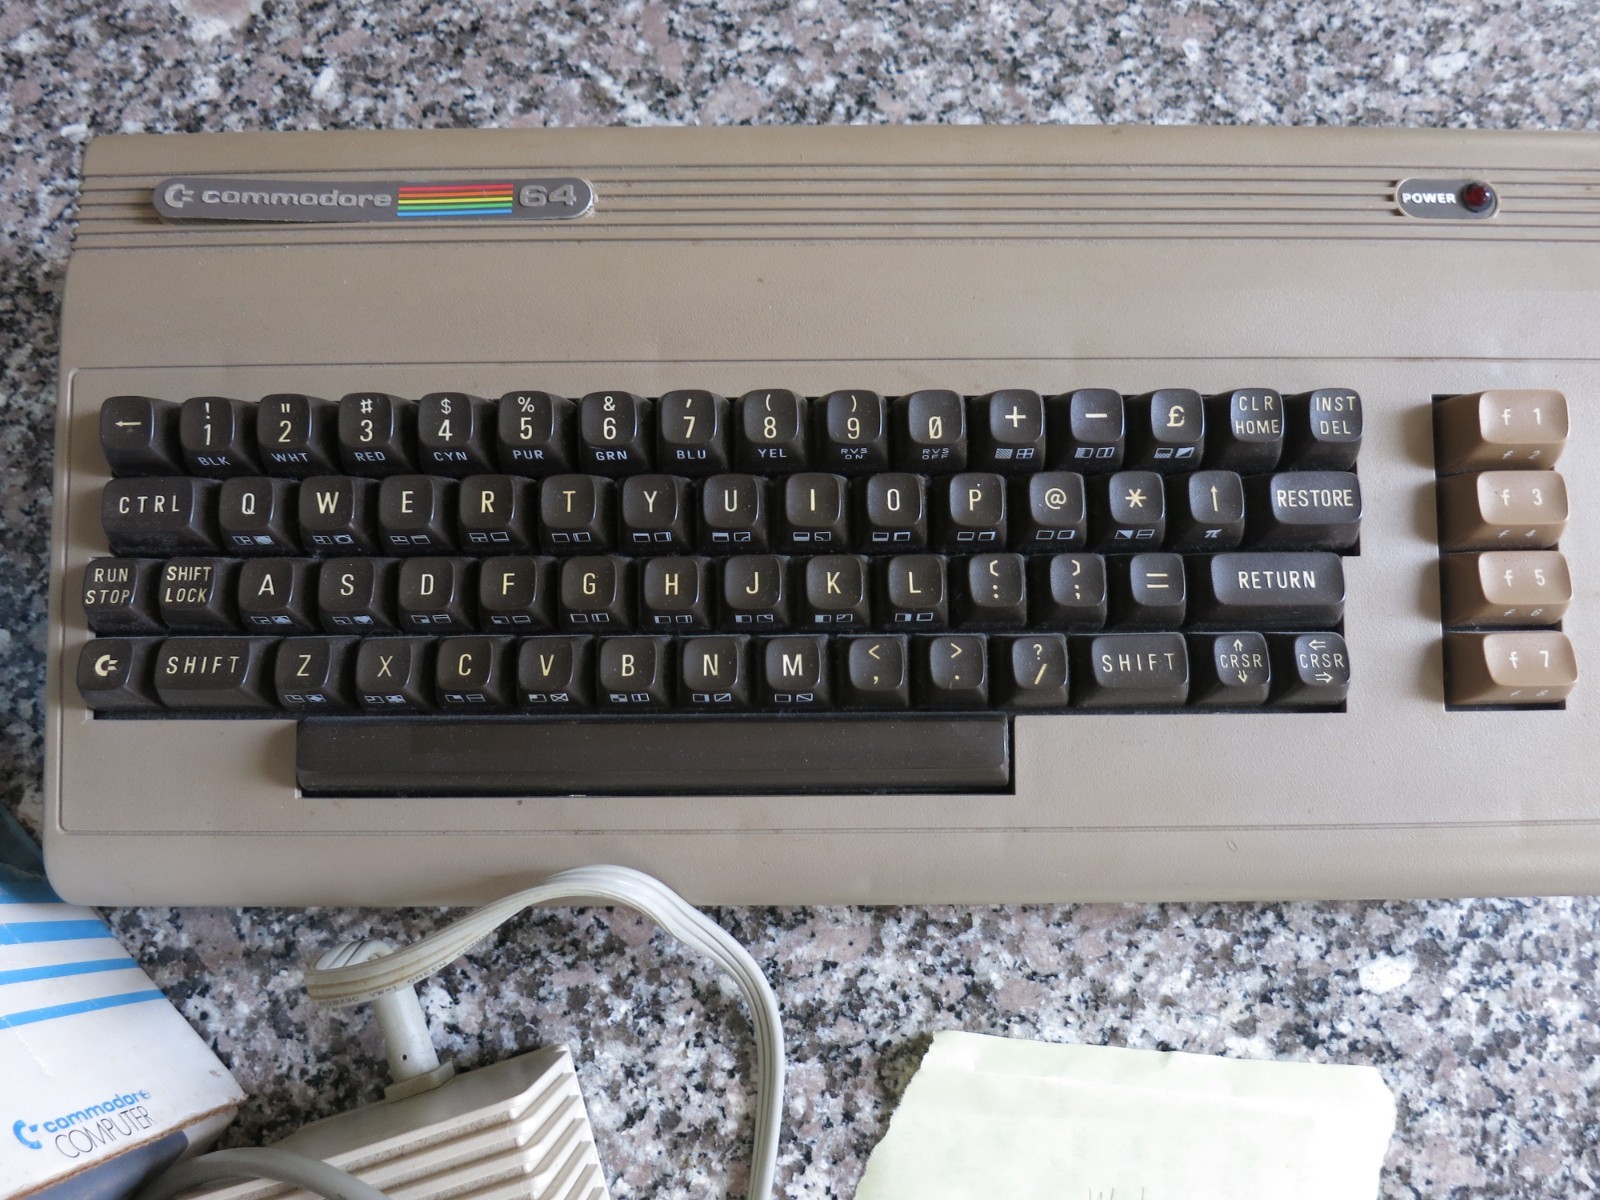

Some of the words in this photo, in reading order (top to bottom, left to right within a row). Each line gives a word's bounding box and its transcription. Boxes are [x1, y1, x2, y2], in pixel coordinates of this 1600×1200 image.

[201, 188, 392, 208] commodore
[519, 184, 577, 207] 64
[1402, 192, 1457, 204] POWER
[361, 399, 372, 413] #
[441, 398, 451, 414] $
[518, 397, 534, 412] %
[604, 396, 615, 411] &
[1239, 396, 1273, 411] CLR
[1316, 397, 1355, 411] INST
[1167, 406, 1184, 426] £
[1236, 419, 1279, 434] HOME
[204, 424, 211, 445] 1
[279, 421, 291, 442] 2
[360, 420, 372, 441] 3
[439, 420, 452, 441] 4
[520, 418, 532, 439] 5
[604, 418, 616, 439] 6
[684, 416, 695, 438] 7
[764, 417, 776, 438] 8
[848, 418, 859, 439] 9
[1320, 421, 1350, 434] DEL
[198, 457, 230, 465] BLK
[271, 453, 307, 462] WHT
[355, 452, 385, 461] RED
[434, 452, 467, 461] CYN
[513, 450, 543, 459] PUR
[596, 451, 627, 460] GRN
[677, 450, 705, 459] BLU
[758, 449, 786, 457] YEL
[120, 496, 179, 513] CTRL
[242, 493, 255, 514] Q
[317, 492, 338, 513] W
[402, 491, 413, 513] E
[482, 491, 494, 512] R
[563, 491, 575, 512] T
[644, 491, 657, 512] Y
[725, 490, 737, 511] U
[888, 489, 900, 510] O
[969, 490, 981, 510] P
[1045, 488, 1066, 509] @
[1277, 489, 1353, 508] RESTORE
[95, 568, 128, 582] RUN
[167, 566, 211, 580] SHIFT
[503, 573, 514, 594] F
[584, 573, 595, 594] G
[746, 572, 758, 594] J
[827, 572, 841, 593] K
[909, 572, 921, 593] L
[1239, 571, 1315, 588] RETURN
[165, 588, 206, 602] LOCK
[258, 574, 274, 595] A
[341, 574, 354, 595] S
[421, 574, 433, 595] D
[666, 574, 678, 595] H
[85, 590, 129, 604] STOP
[1034, 644, 1042, 660] ?
[1220, 654, 1261, 669] CRSR
[1300, 654, 1344, 668] CRSR
[167, 656, 239, 674] SHIFT
[297, 655, 311, 676] Z
[378, 656, 392, 677] X
[459, 654, 471, 675] C
[540, 655, 554, 676] V
[622, 655, 634, 676] B
[704, 654, 717, 676] N
[783, 654, 802, 676] M
[1102, 654, 1173, 672] SHIFT
[1035, 664, 1046, 684] /
[407, 961, 447, 984] GREEN
[43, 1090, 151, 1134] commodore
[54, 1105, 155, 1158] COMPUTER
